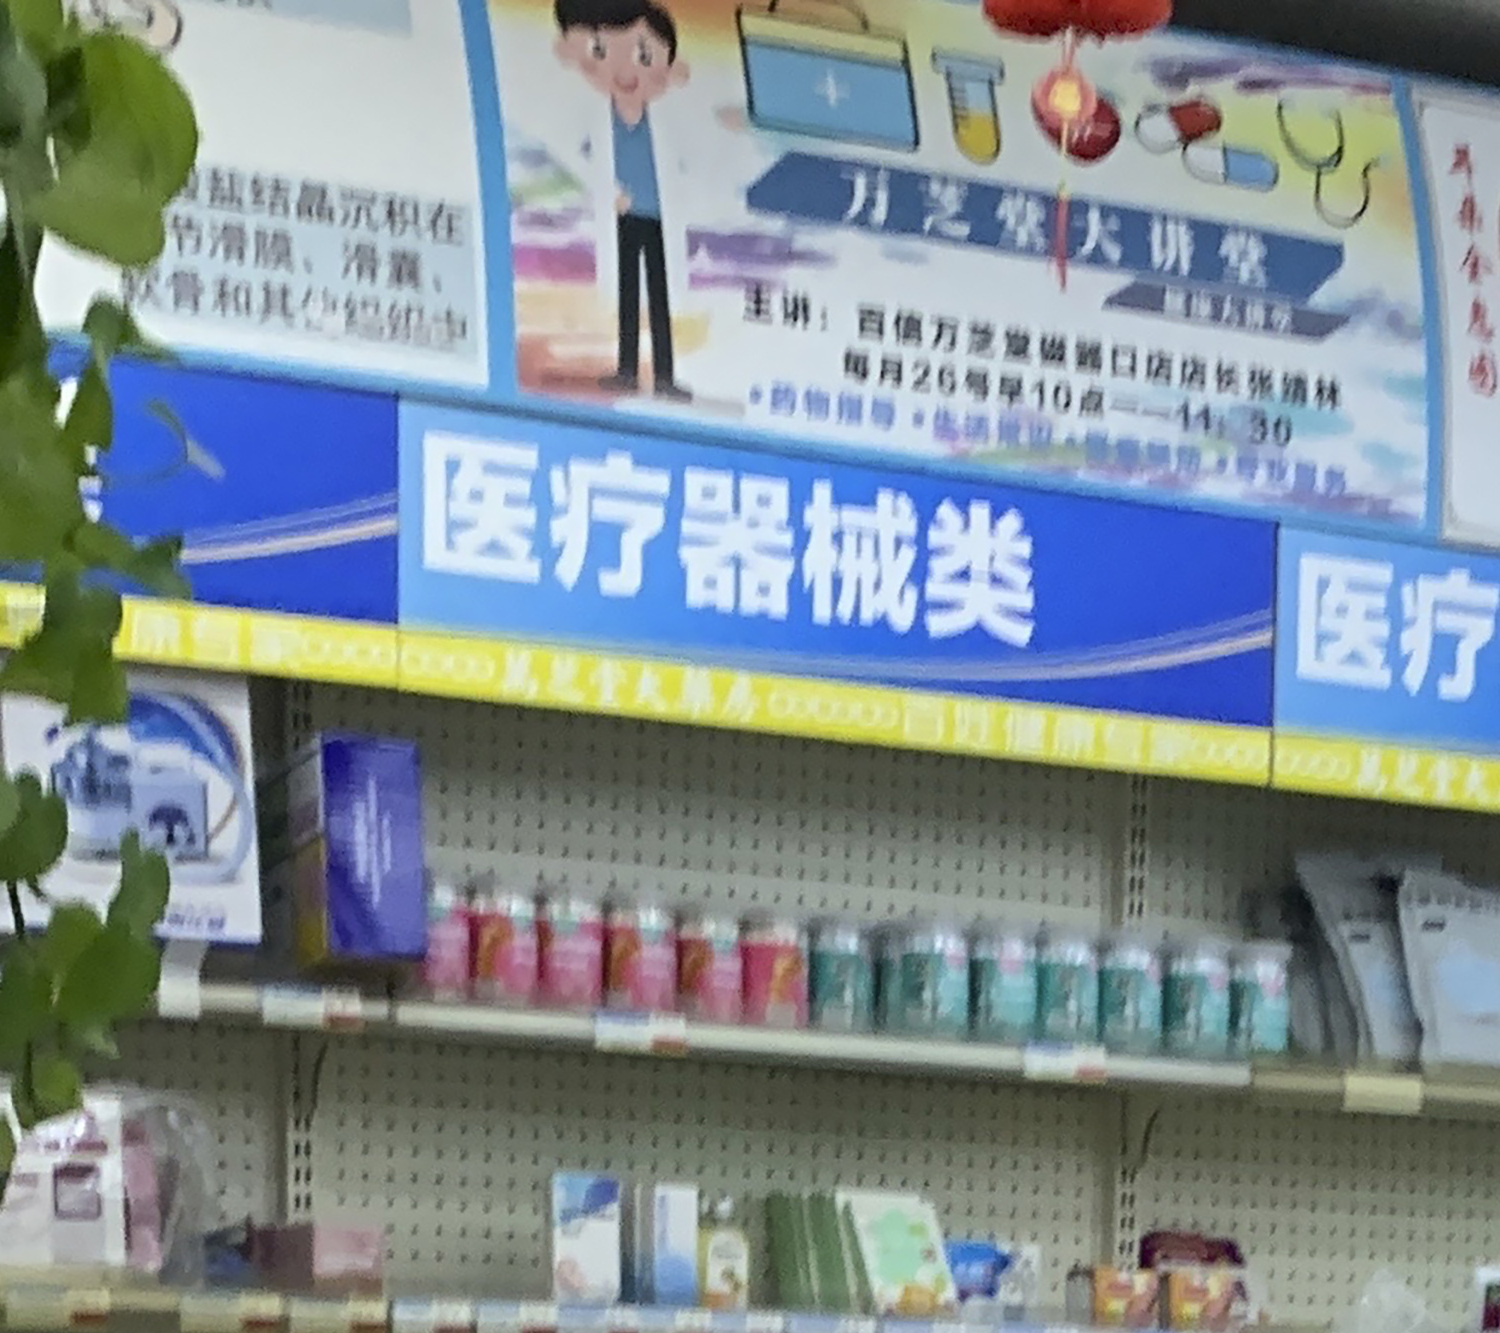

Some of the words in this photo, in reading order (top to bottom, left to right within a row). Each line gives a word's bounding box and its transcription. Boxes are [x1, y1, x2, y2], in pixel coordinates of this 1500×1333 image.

[421, 430, 1036, 649] 医疗器械类
